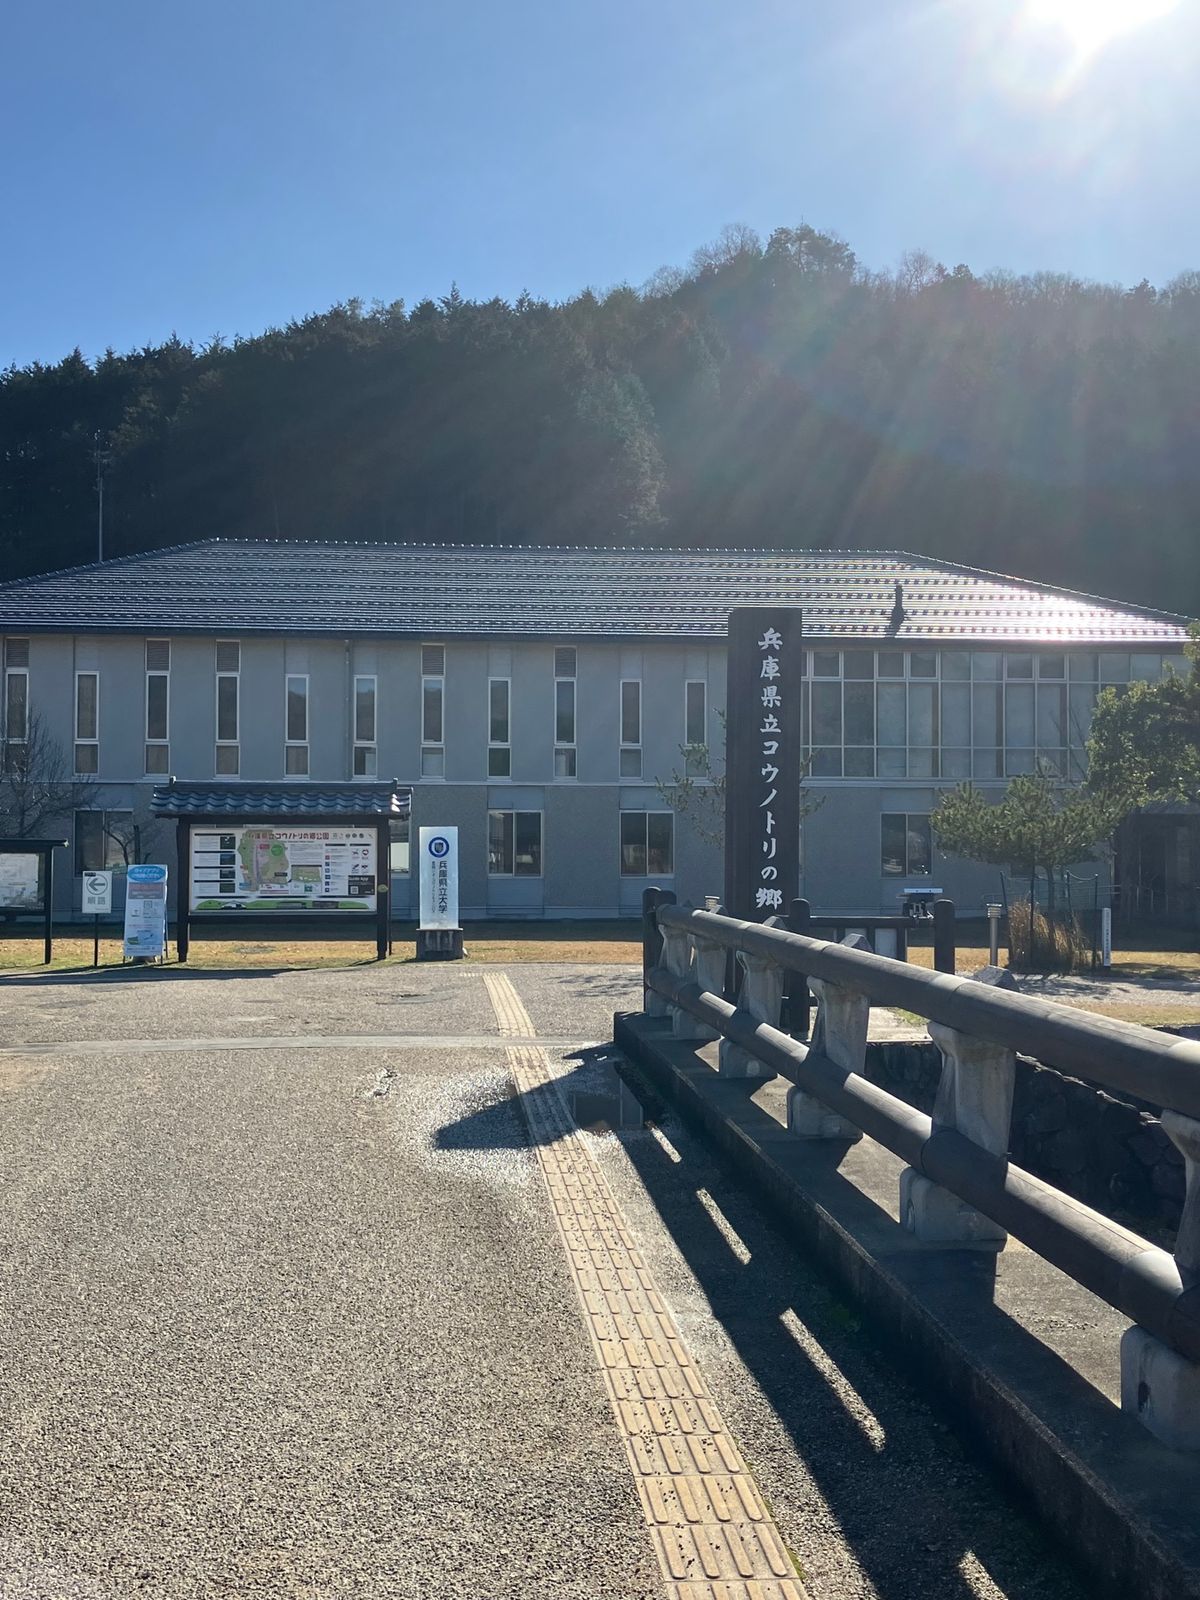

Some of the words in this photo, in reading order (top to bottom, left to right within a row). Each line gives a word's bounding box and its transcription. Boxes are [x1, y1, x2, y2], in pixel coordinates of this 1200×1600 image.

[756, 627, 783, 911] 兵庫県立コウノトリの郷
[438, 860, 448, 914] 兵庫県立大学
